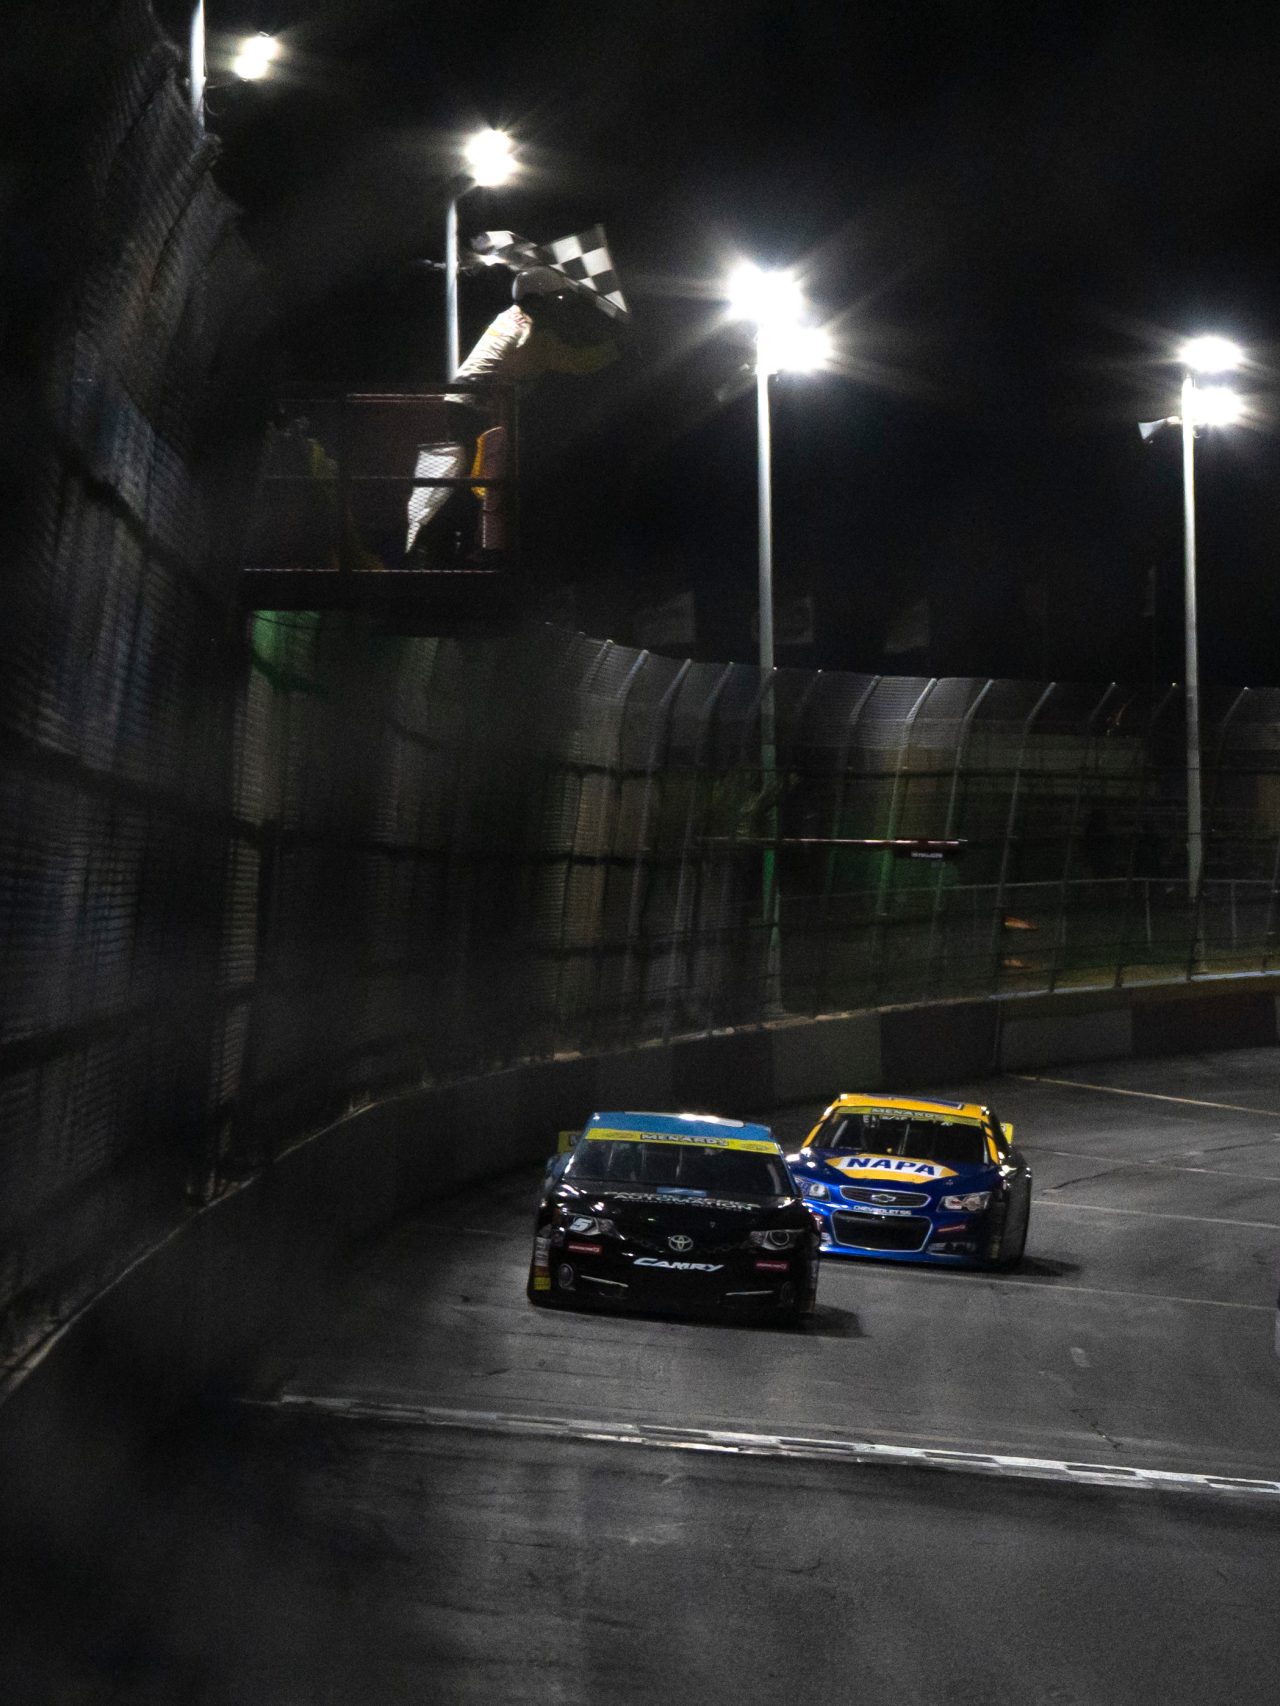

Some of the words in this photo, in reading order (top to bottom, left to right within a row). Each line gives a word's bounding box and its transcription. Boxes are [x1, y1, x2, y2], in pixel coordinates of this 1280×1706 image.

[641, 1133, 729, 1147] MENARDS
[846, 1158, 936, 1176] NAPA
[633, 1257, 726, 1272] CAMRY
